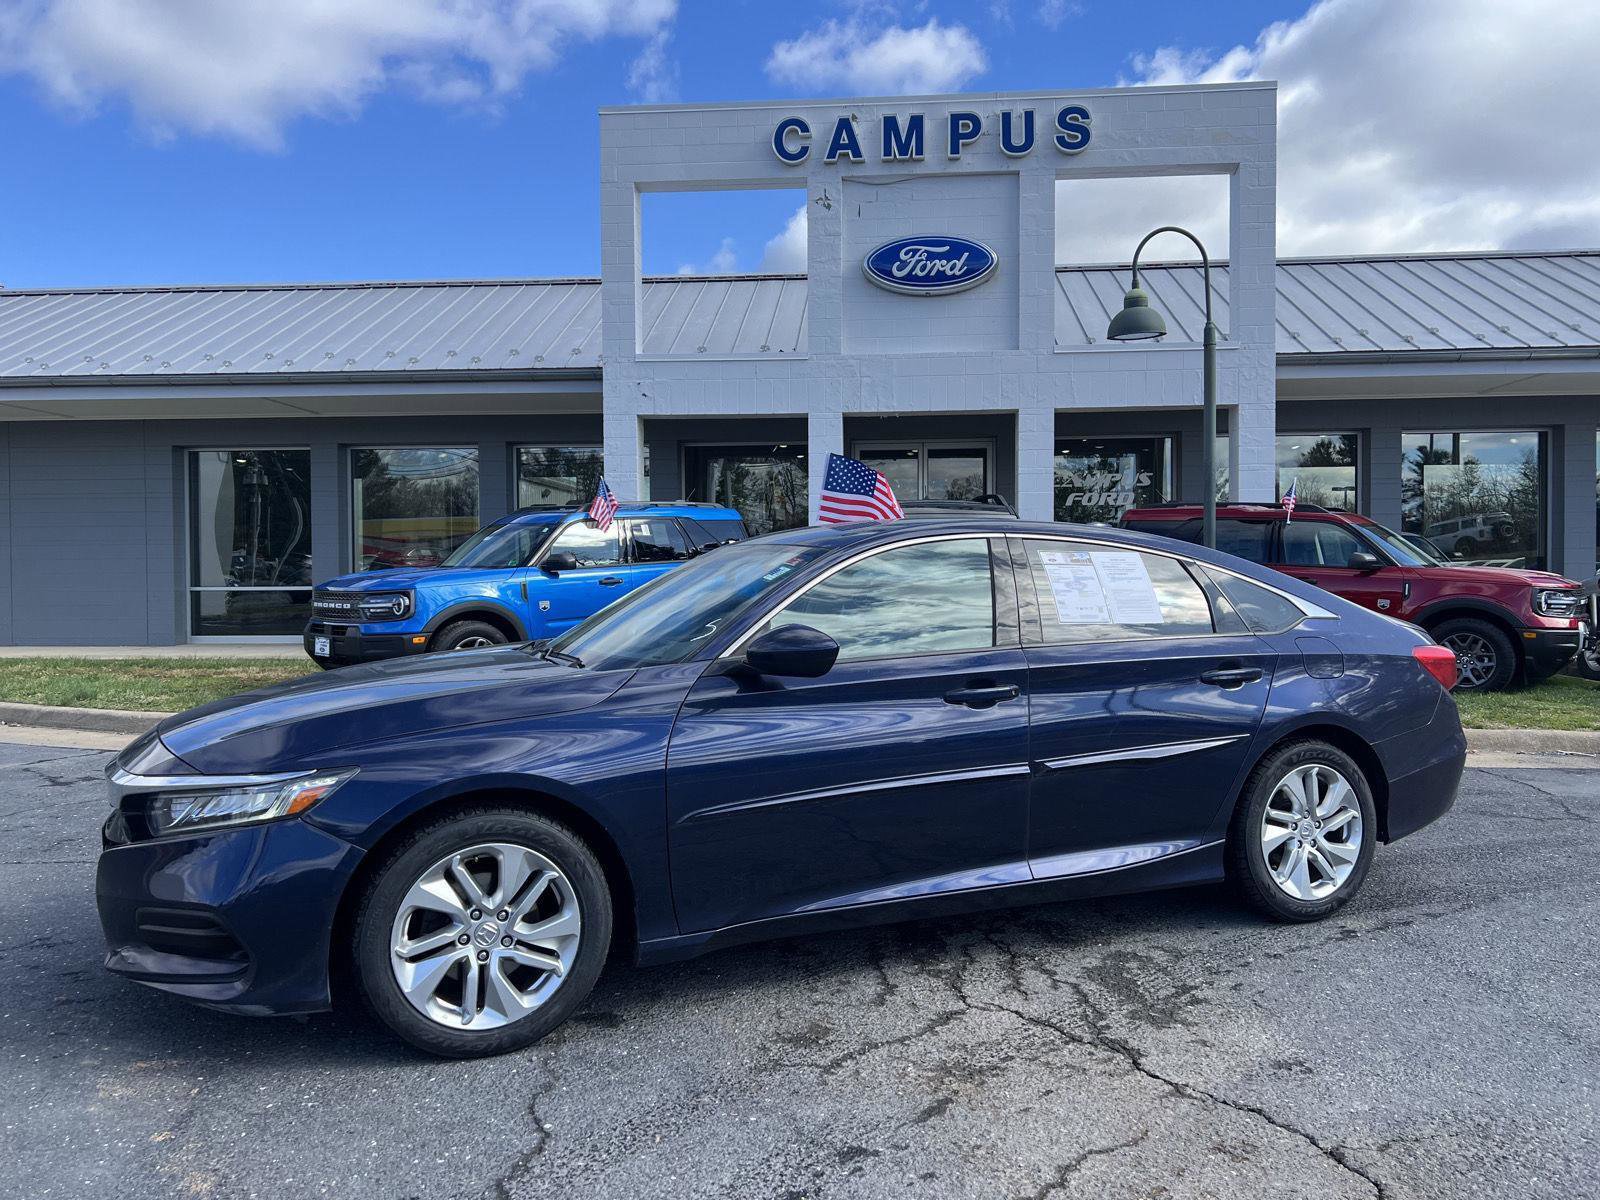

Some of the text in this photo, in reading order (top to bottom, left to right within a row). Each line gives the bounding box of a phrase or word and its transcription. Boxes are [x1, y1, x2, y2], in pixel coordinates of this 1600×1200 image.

[772, 104, 1093, 166] CAMPUS
[891, 245, 970, 278] Ford
[1065, 492, 1135, 506] FORD
[313, 601, 351, 609] BRONCO
